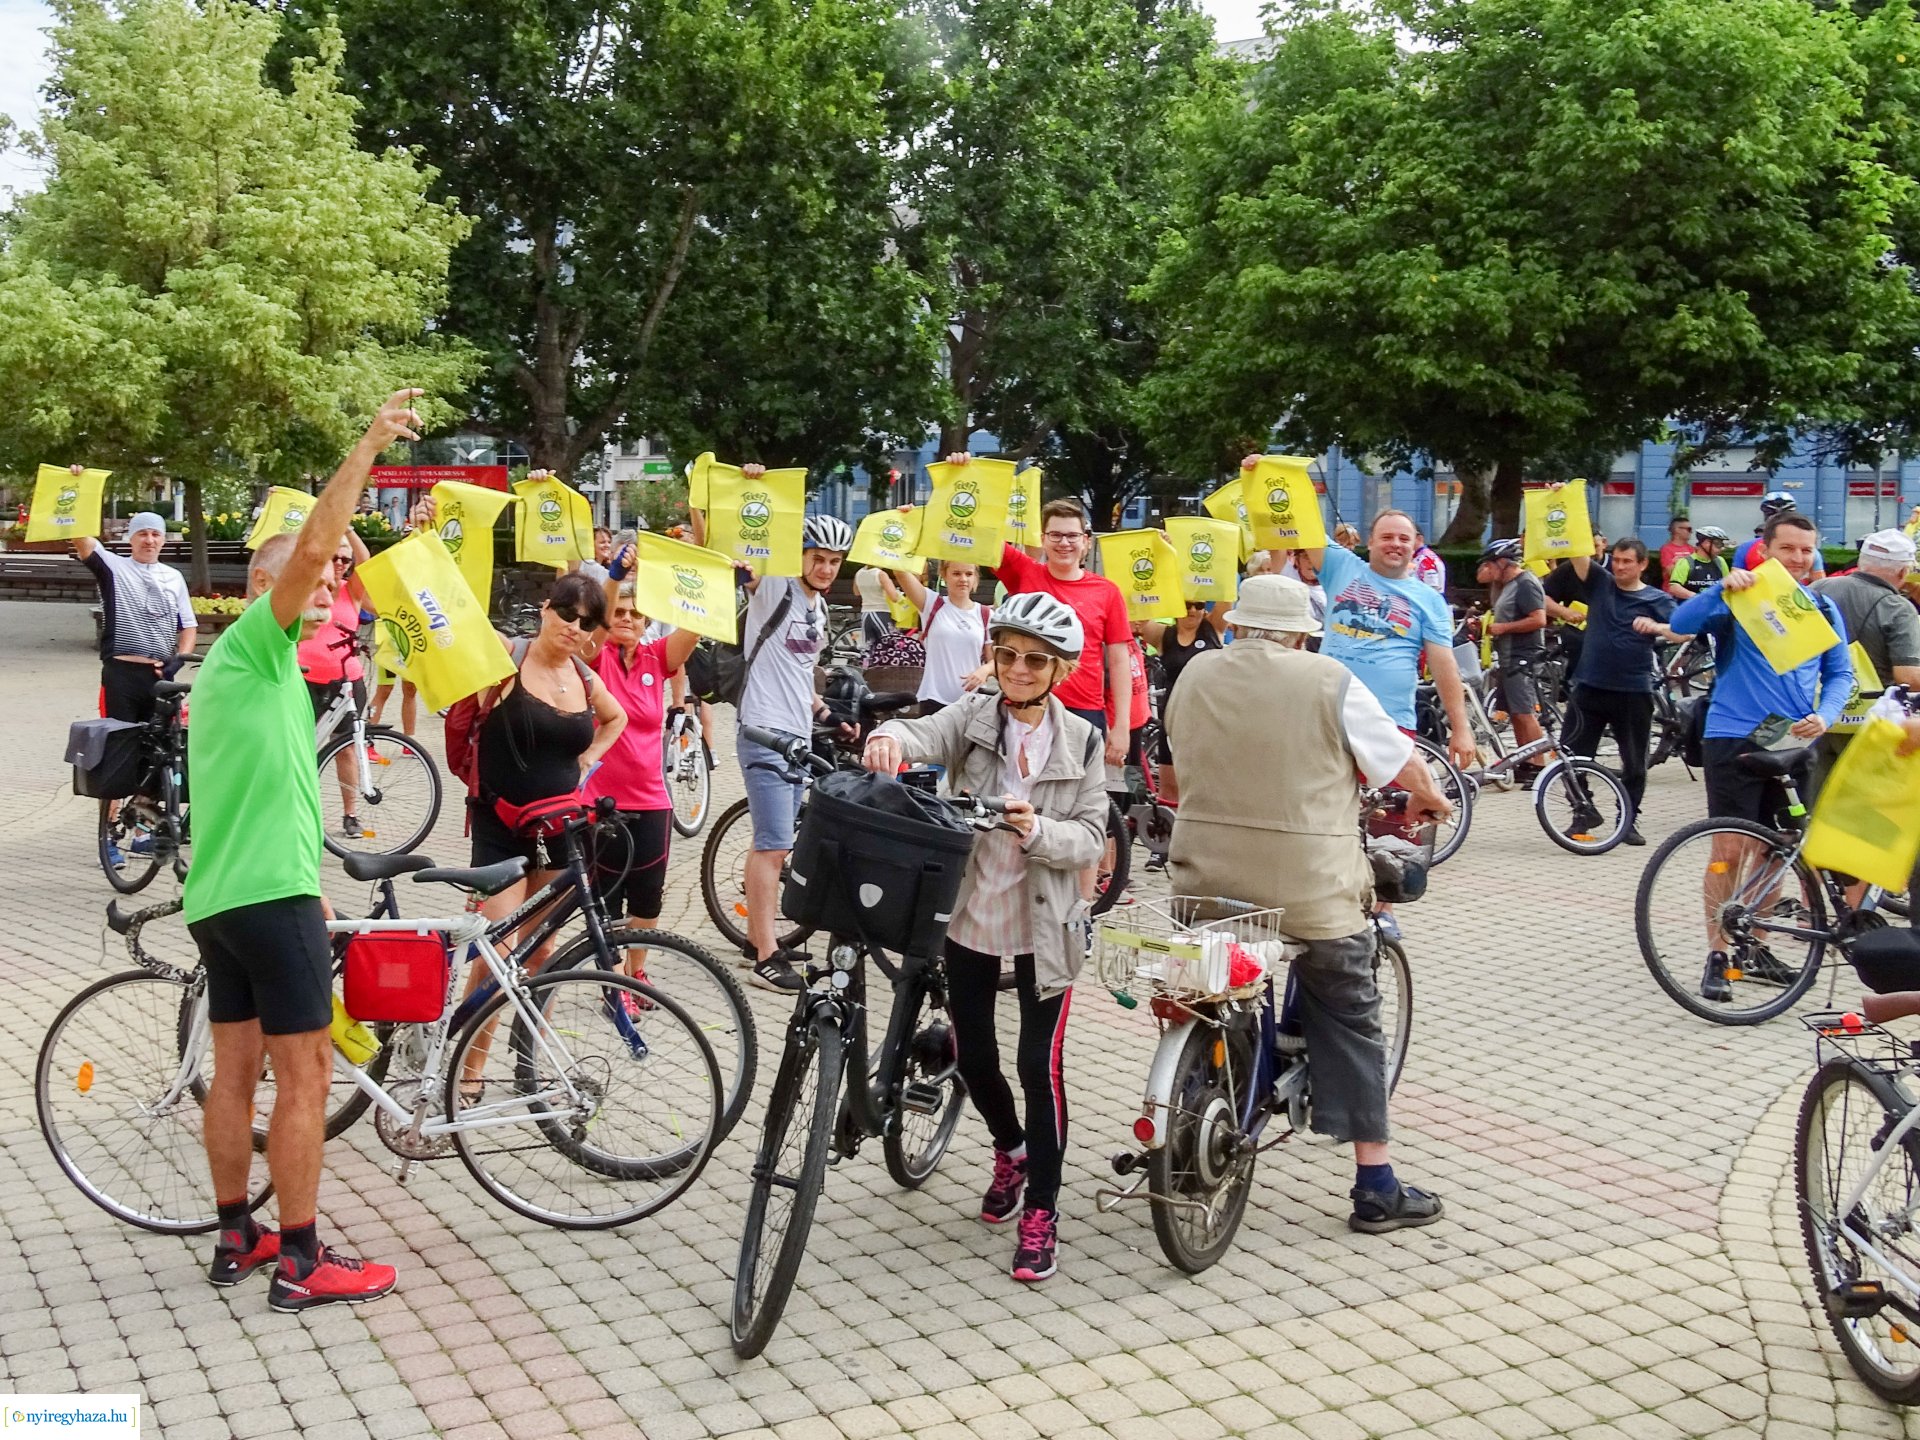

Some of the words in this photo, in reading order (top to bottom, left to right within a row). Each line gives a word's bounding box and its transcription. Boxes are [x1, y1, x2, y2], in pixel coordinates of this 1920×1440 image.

[1279, 528, 1299, 537] lynx
[546, 535, 566, 544] lynx
[949, 533, 973, 544] lynx
[745, 544, 770, 556] lynx
[1193, 575, 1213, 584] lynx
[1140, 594, 1160, 603] lynx
[416, 590, 450, 630] lynx
[682, 600, 706, 615] lynx
